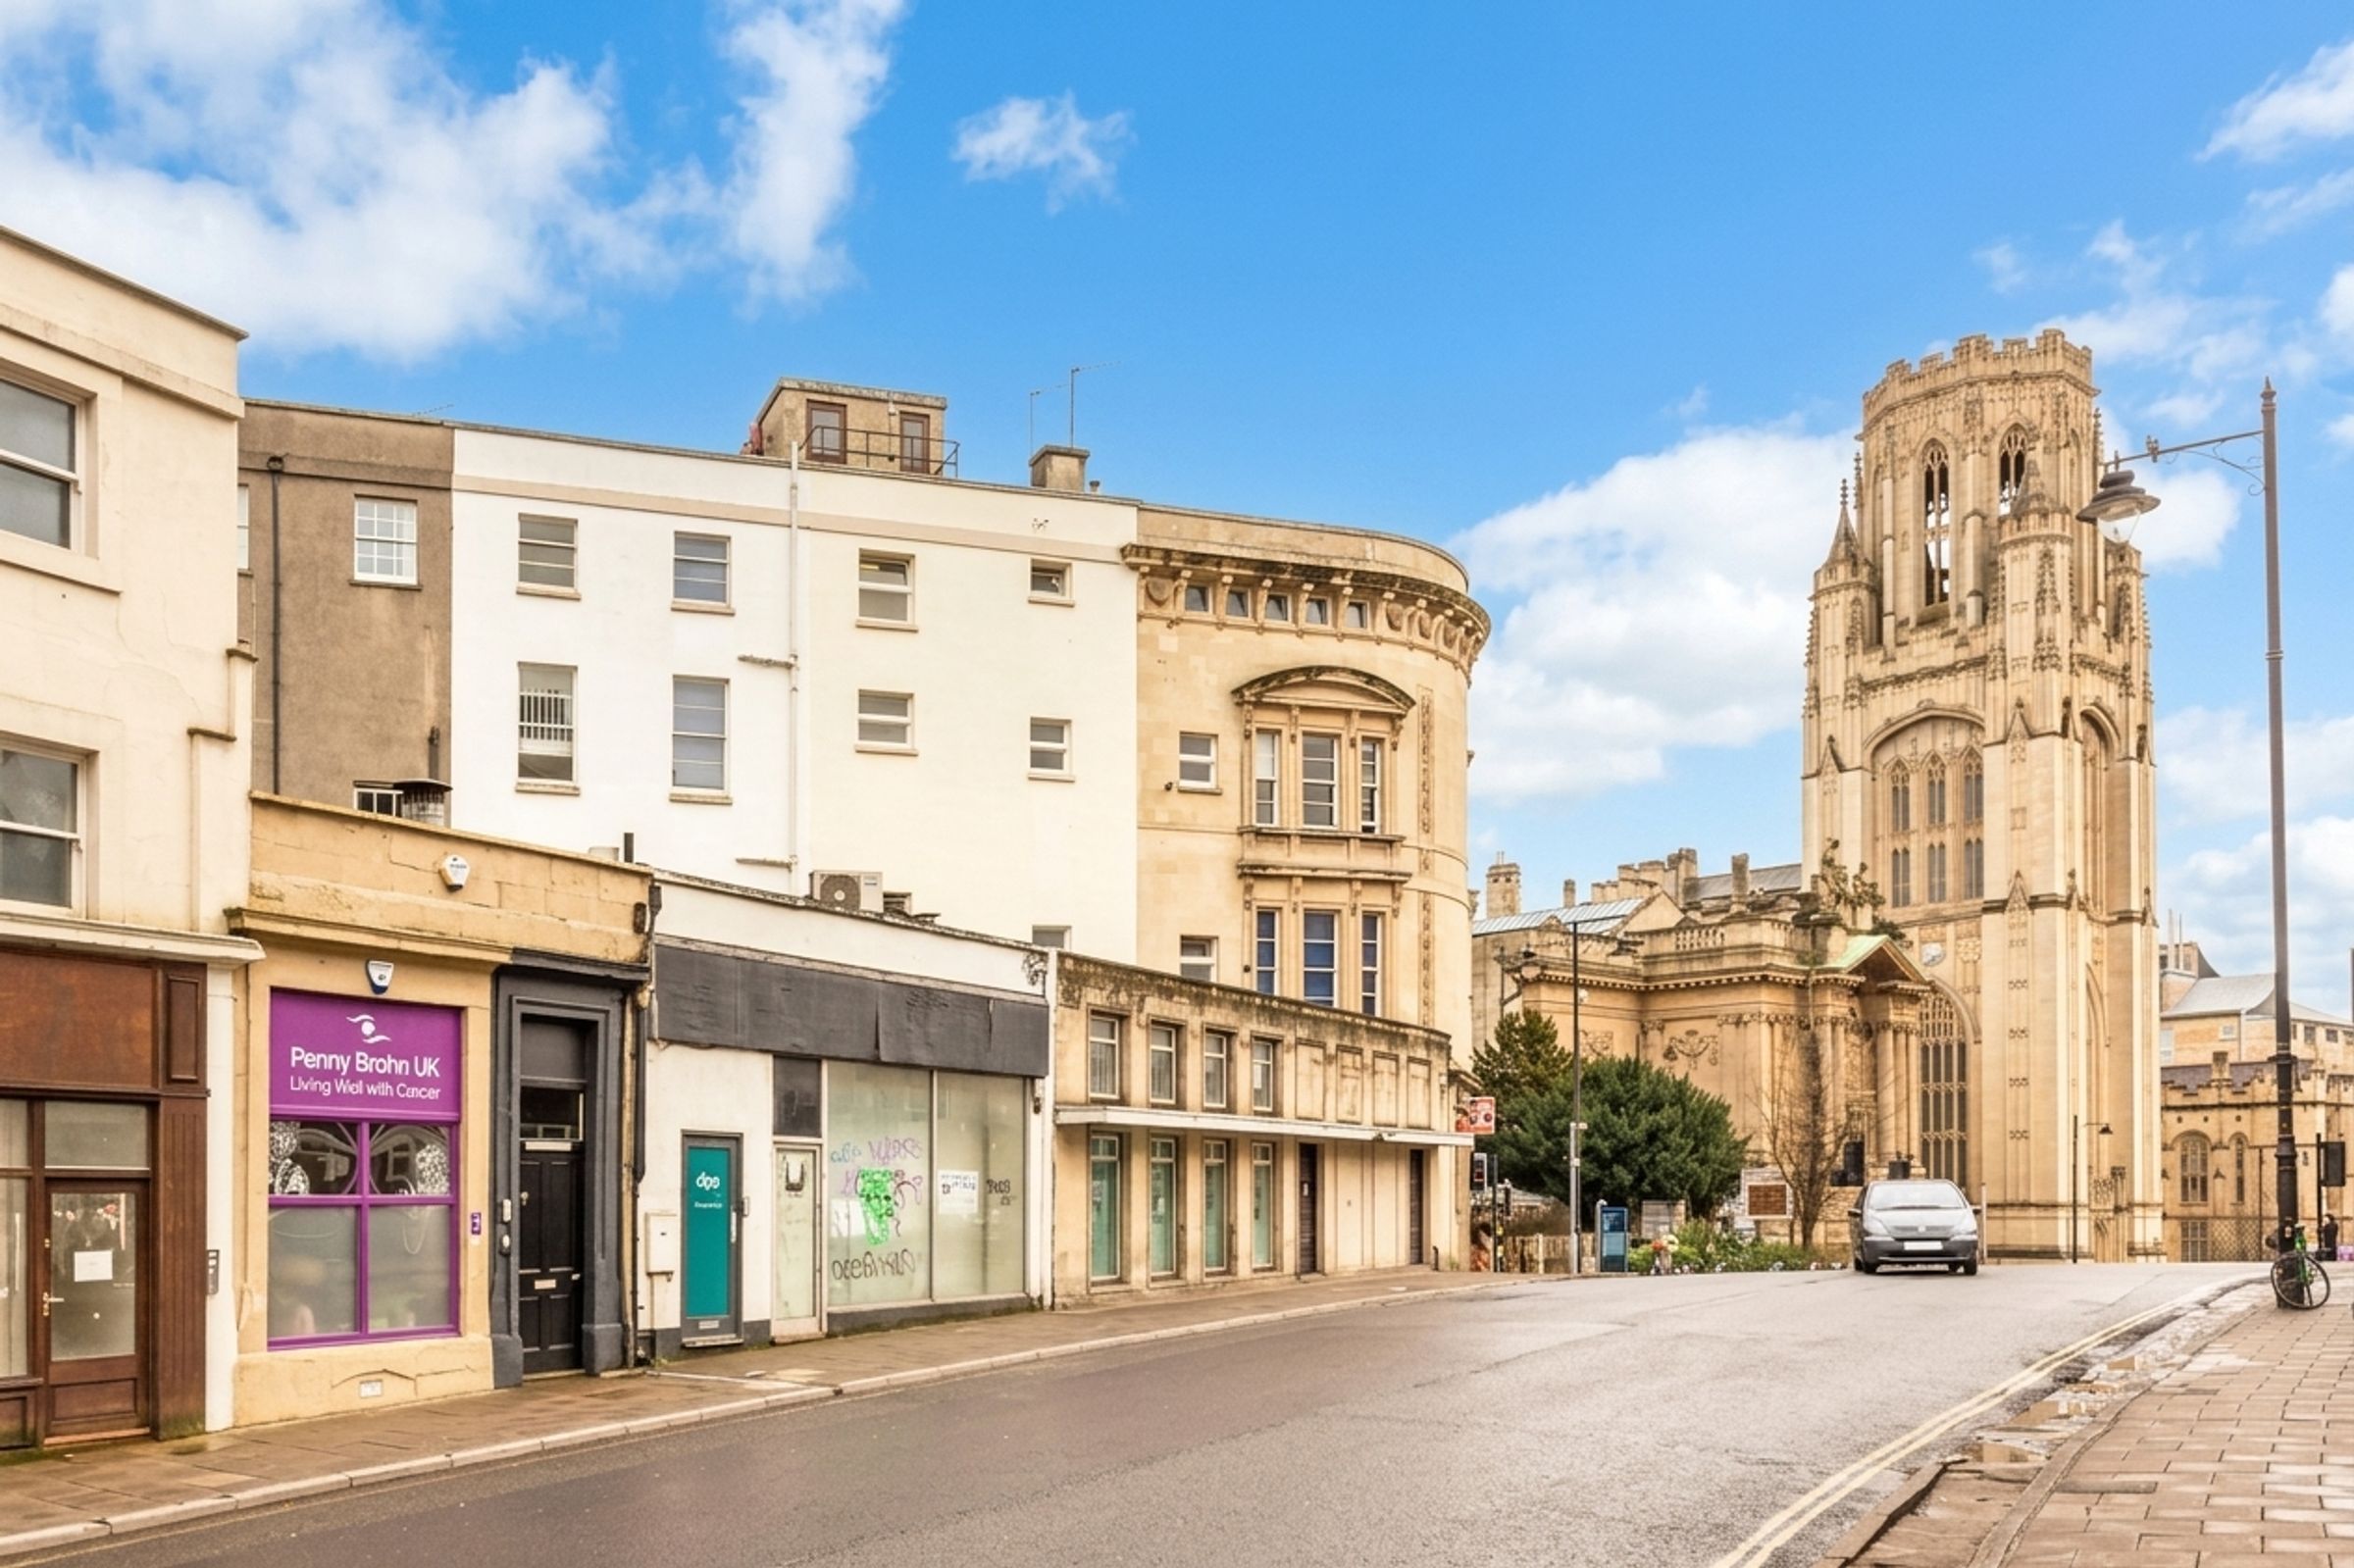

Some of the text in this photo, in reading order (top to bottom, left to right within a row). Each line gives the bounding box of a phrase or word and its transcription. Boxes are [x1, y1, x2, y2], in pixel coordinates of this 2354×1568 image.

[290, 1046, 440, 1078] Penny Brohn UK
[290, 1076, 331, 1096] Living
[366, 1083, 393, 1097] with
[396, 1084, 440, 1099] Cancer
